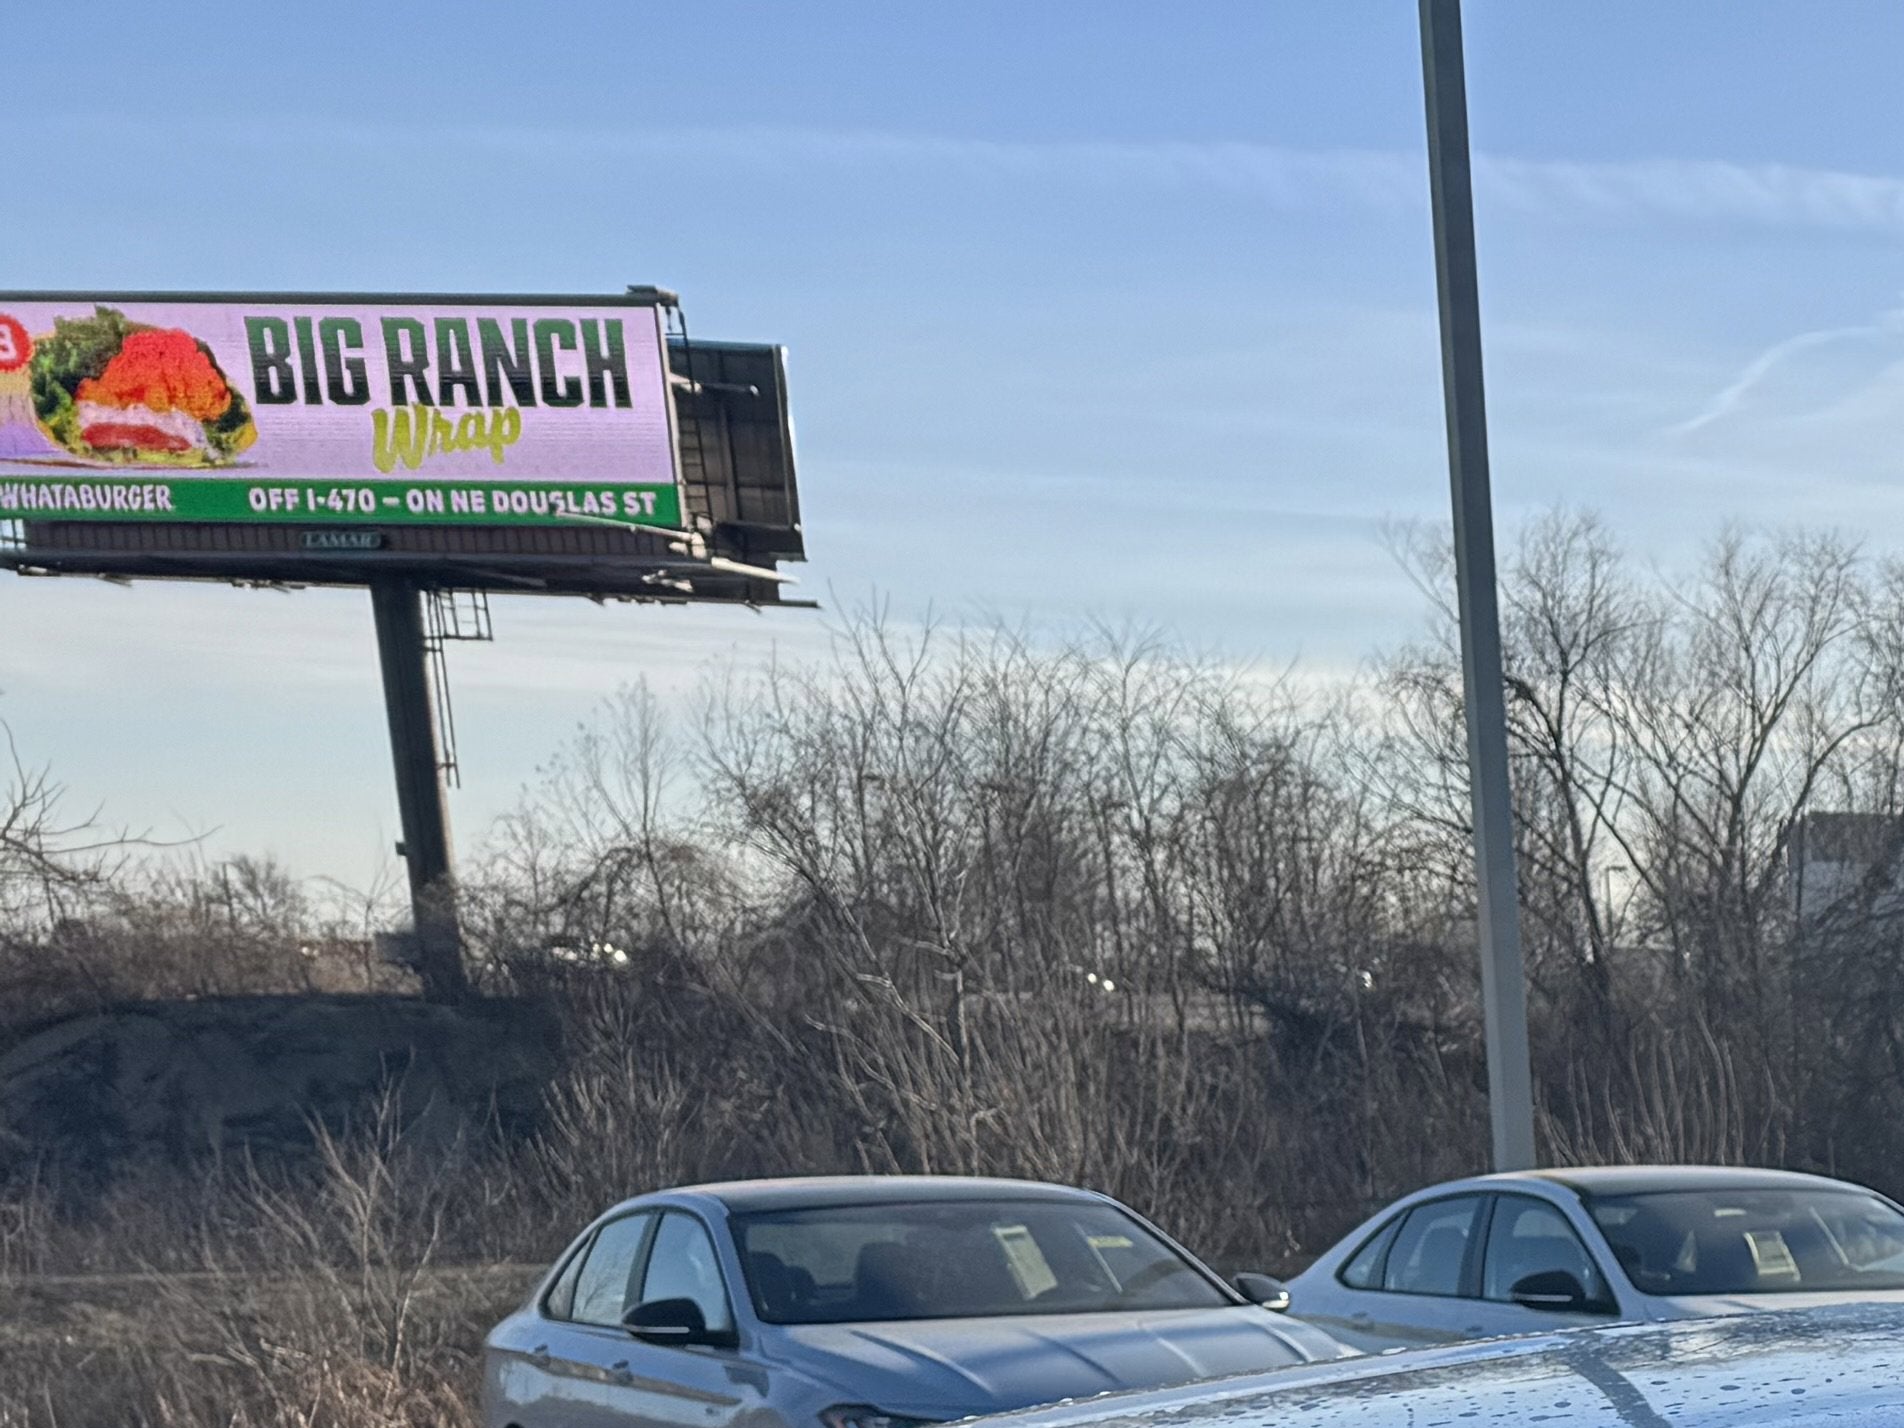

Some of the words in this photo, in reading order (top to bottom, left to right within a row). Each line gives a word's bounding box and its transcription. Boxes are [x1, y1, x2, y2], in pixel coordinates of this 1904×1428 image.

[244, 315, 371, 406] BIG
[380, 316, 633, 409] RANCH
[371, 401, 522, 474] Wrap
[249, 487, 300, 512] OFF
[306, 487, 376, 513] I-470
[406, 488, 445, 513] ON
[450, 489, 486, 514] NE
[622, 491, 657, 516] ST
